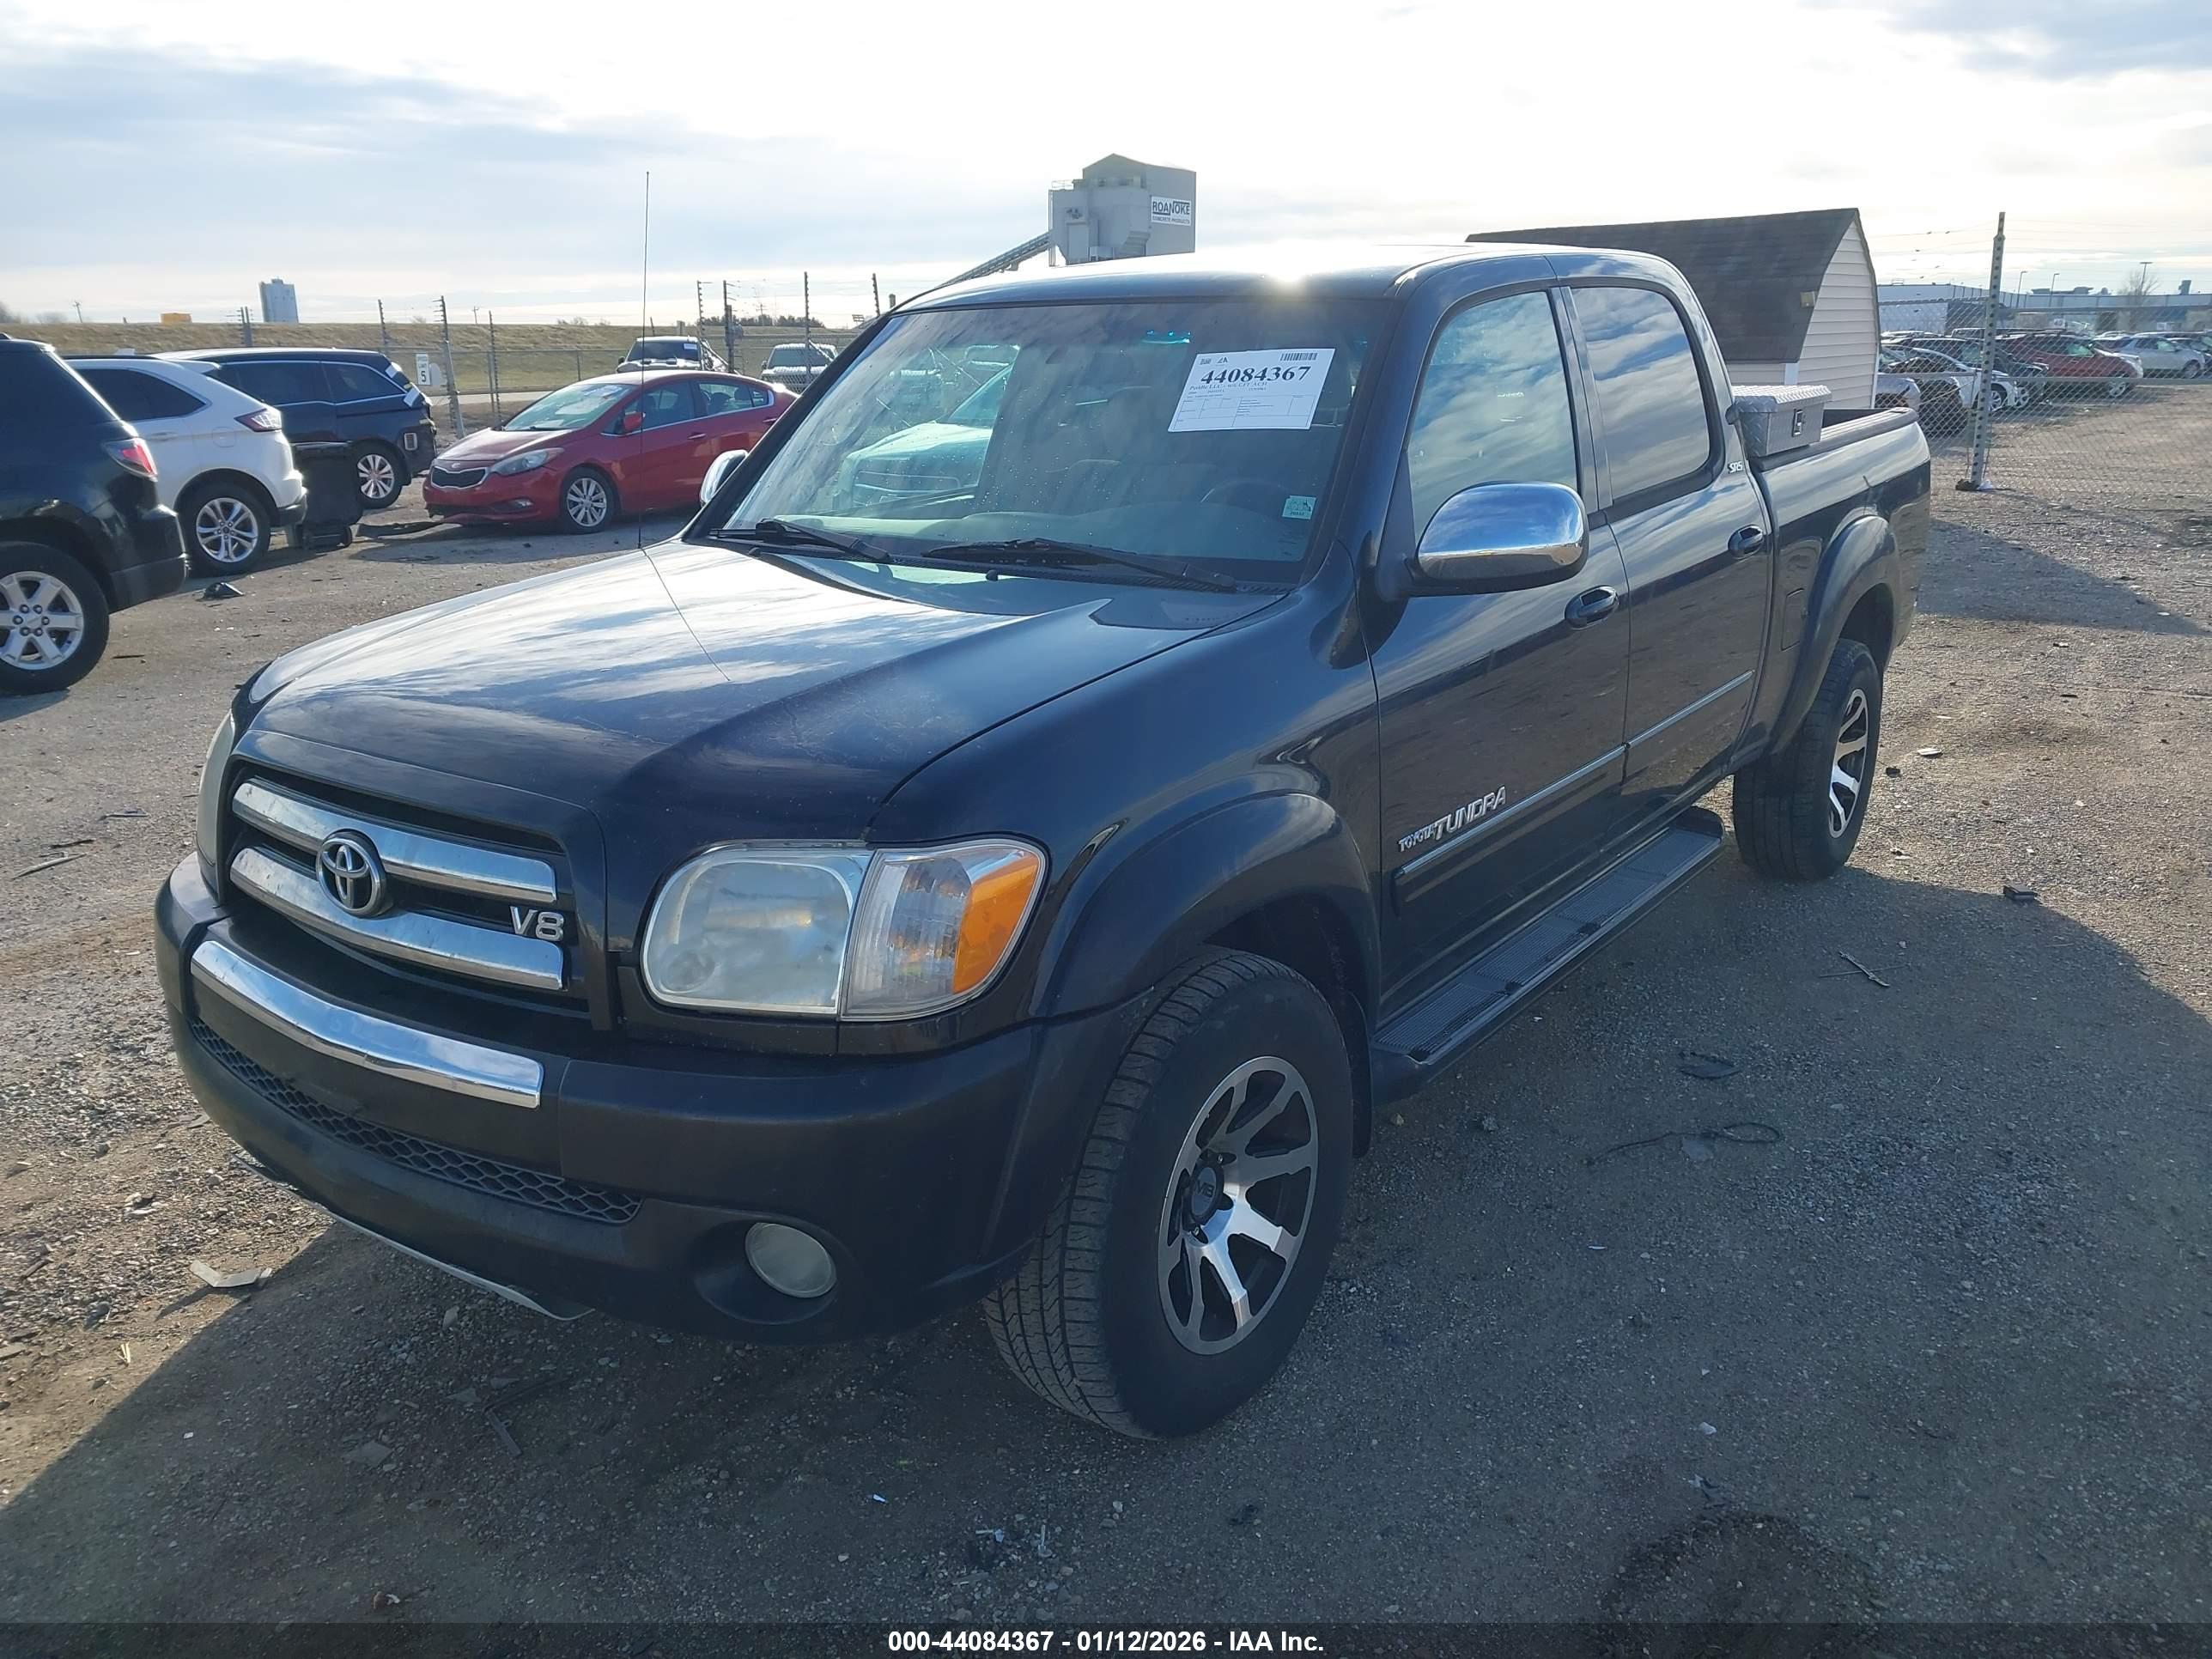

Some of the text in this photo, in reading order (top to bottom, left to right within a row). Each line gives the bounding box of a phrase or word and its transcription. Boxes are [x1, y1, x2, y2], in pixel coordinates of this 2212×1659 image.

[1152, 200, 1190, 215] ROANOKE
[421, 370, 427, 382] 5
[1200, 366, 1311, 384] 44084367
[1398, 786, 1506, 852] TOYOTA TUNDRA
[509, 906, 564, 942] V8
